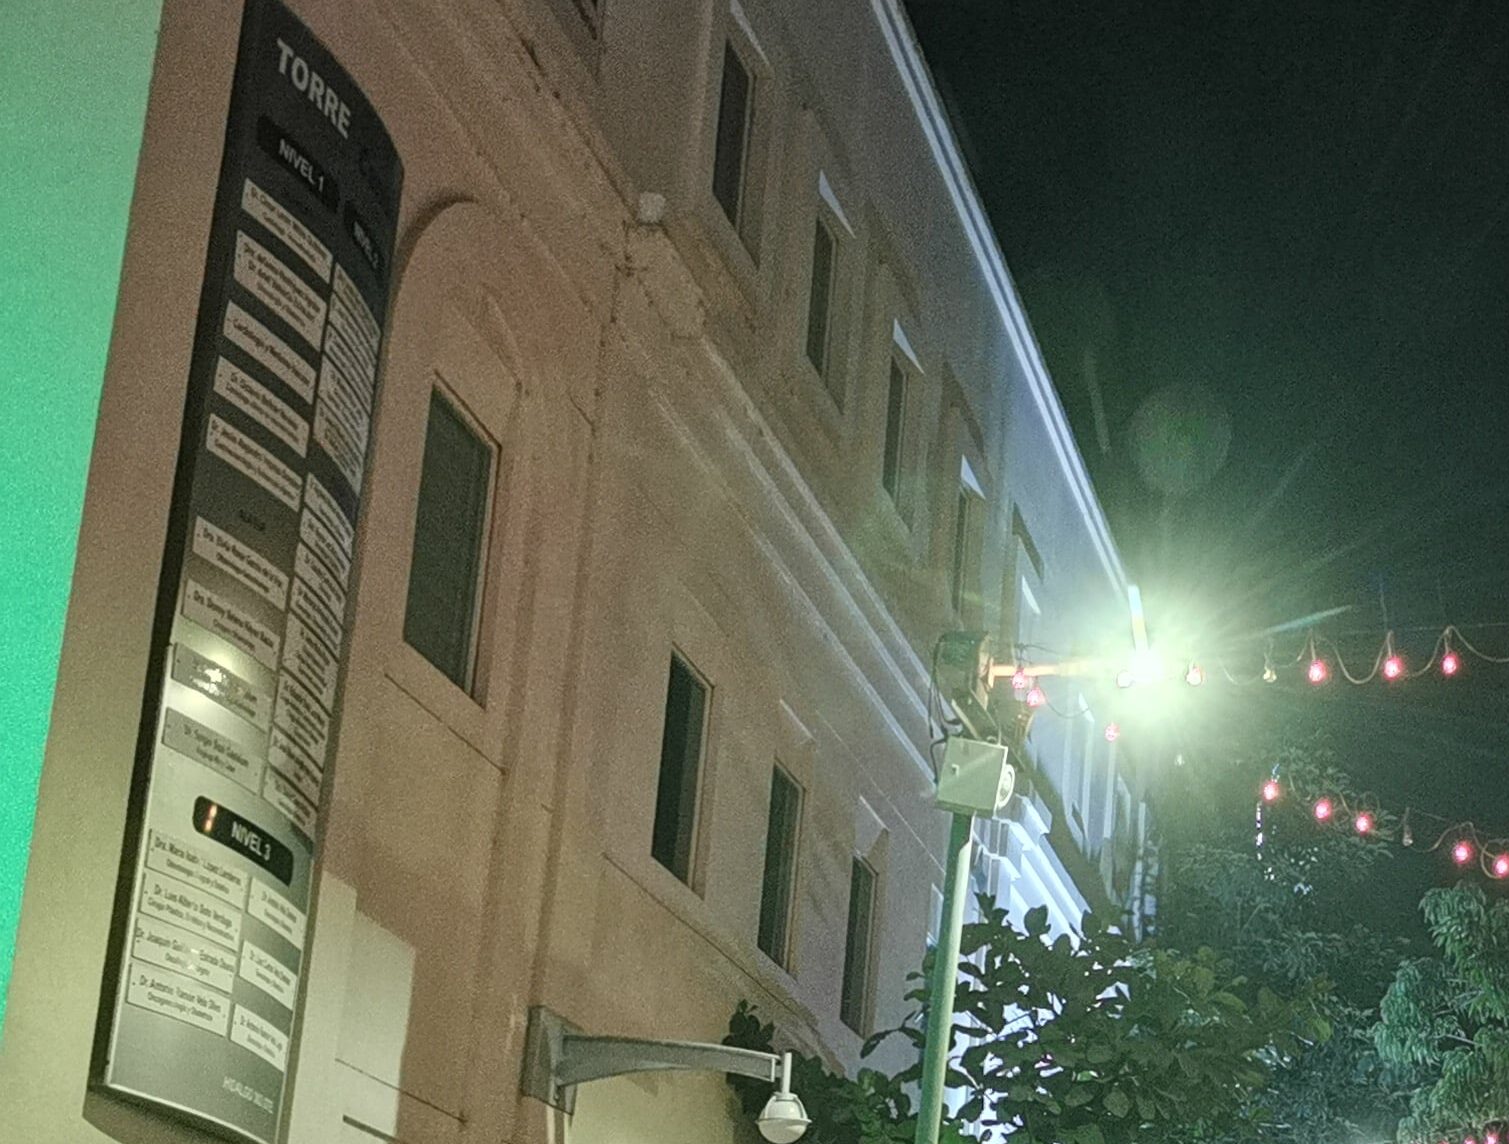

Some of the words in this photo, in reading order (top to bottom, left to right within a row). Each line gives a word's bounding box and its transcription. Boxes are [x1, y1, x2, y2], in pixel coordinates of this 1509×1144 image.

[277, 37, 351, 140] TORRE
[279, 138, 315, 186] NIVEL
[318, 175, 325, 193] 1
[231, 820, 262, 857] NIVEL
[263, 843, 271, 861] 3
